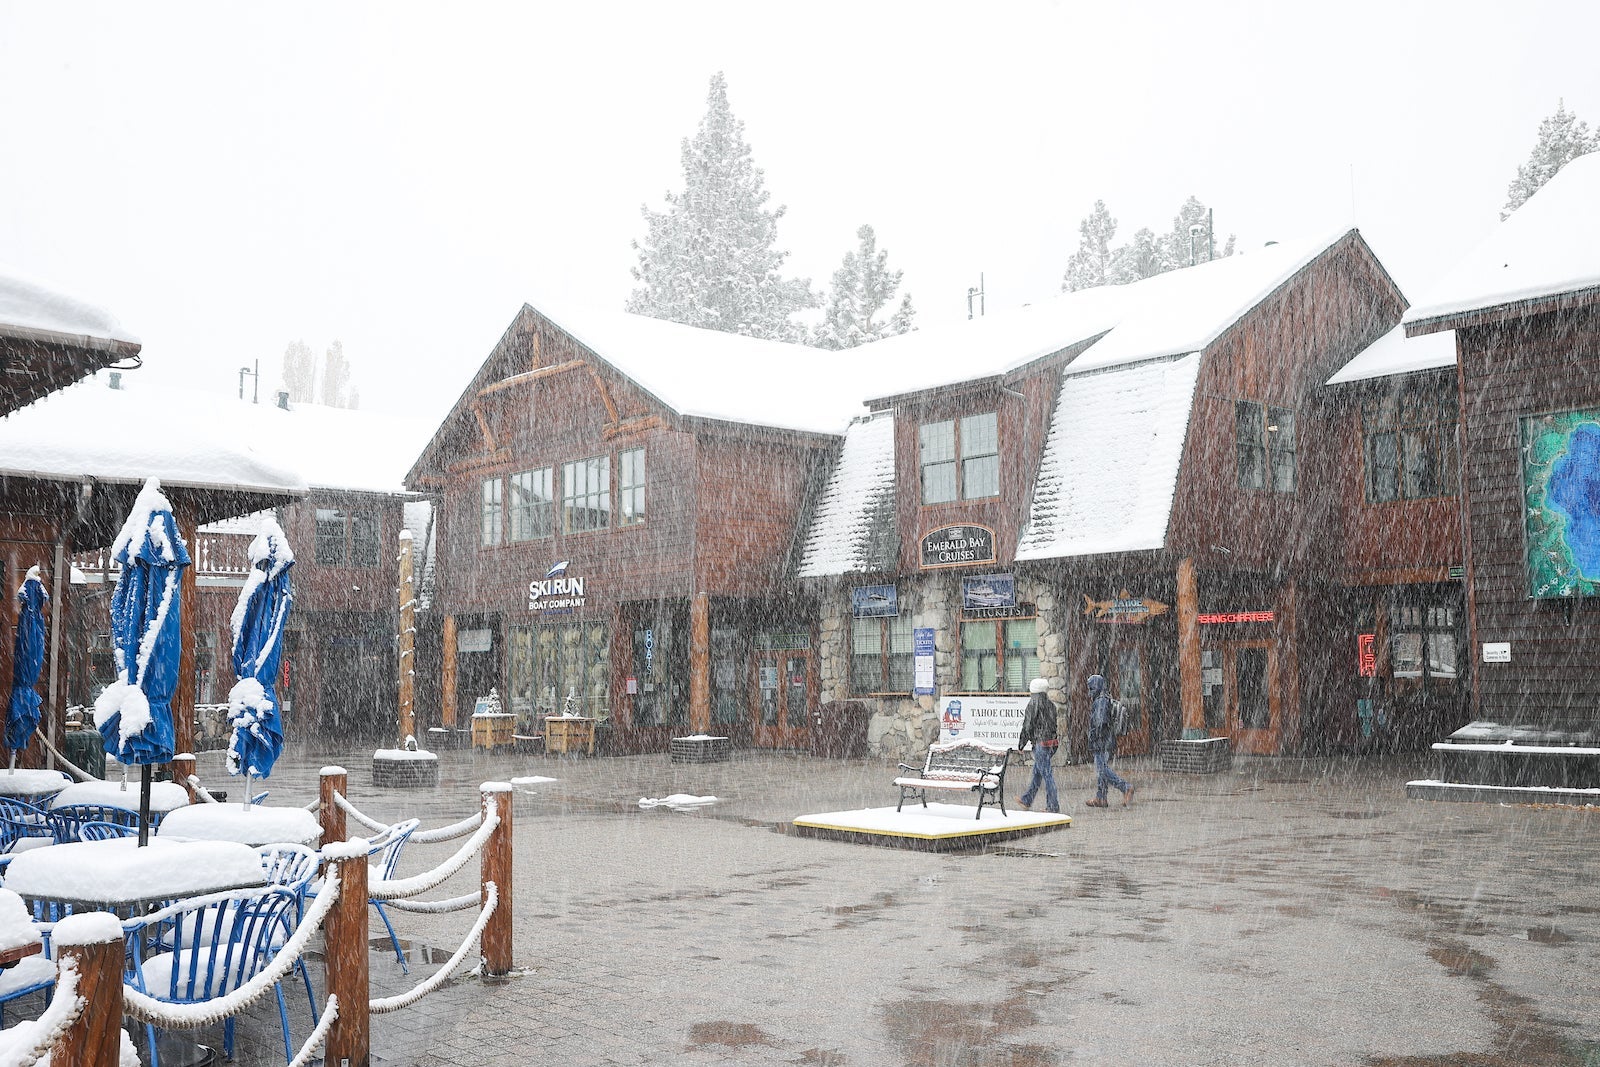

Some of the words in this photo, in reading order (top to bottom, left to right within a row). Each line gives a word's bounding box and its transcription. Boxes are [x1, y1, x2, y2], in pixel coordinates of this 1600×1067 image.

[927, 539, 967, 552] EMERALD
[969, 537, 986, 548] BAY
[939, 550, 975, 562] CRUISES
[529, 580, 551, 600] SKI
[554, 577, 584, 597] RUN
[529, 601, 548, 610] BOAT
[549, 598, 586, 609] COMPANY
[976, 608, 1021, 618] TICKETS
[971, 708, 998, 718] TAHOE
[999, 709, 1025, 718] CRUIS
